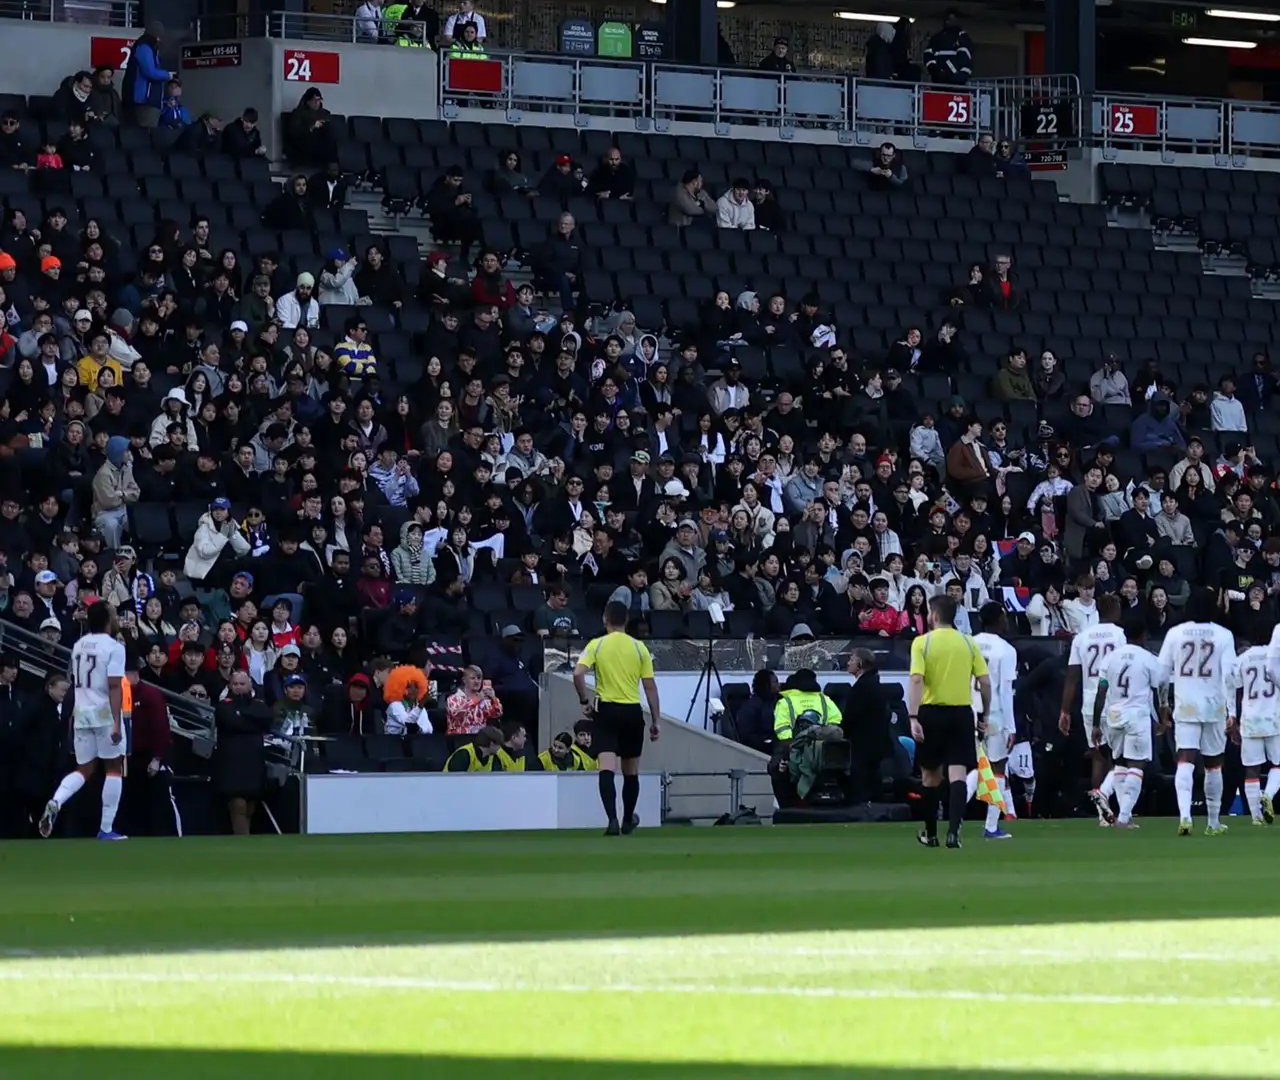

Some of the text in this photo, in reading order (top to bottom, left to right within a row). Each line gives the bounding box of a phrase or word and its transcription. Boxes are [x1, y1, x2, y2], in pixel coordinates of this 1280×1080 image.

[286, 58, 312, 81] 24
[948, 101, 968, 122] 25
[1114, 112, 1134, 132] 25
[1036, 114, 1058, 134] 22
[76, 653, 96, 688] 17
[1180, 641, 1216, 678] 22
[1117, 663, 1130, 698] 4
[1246, 665, 1275, 700] 25
[1019, 754, 1028, 768] 11
